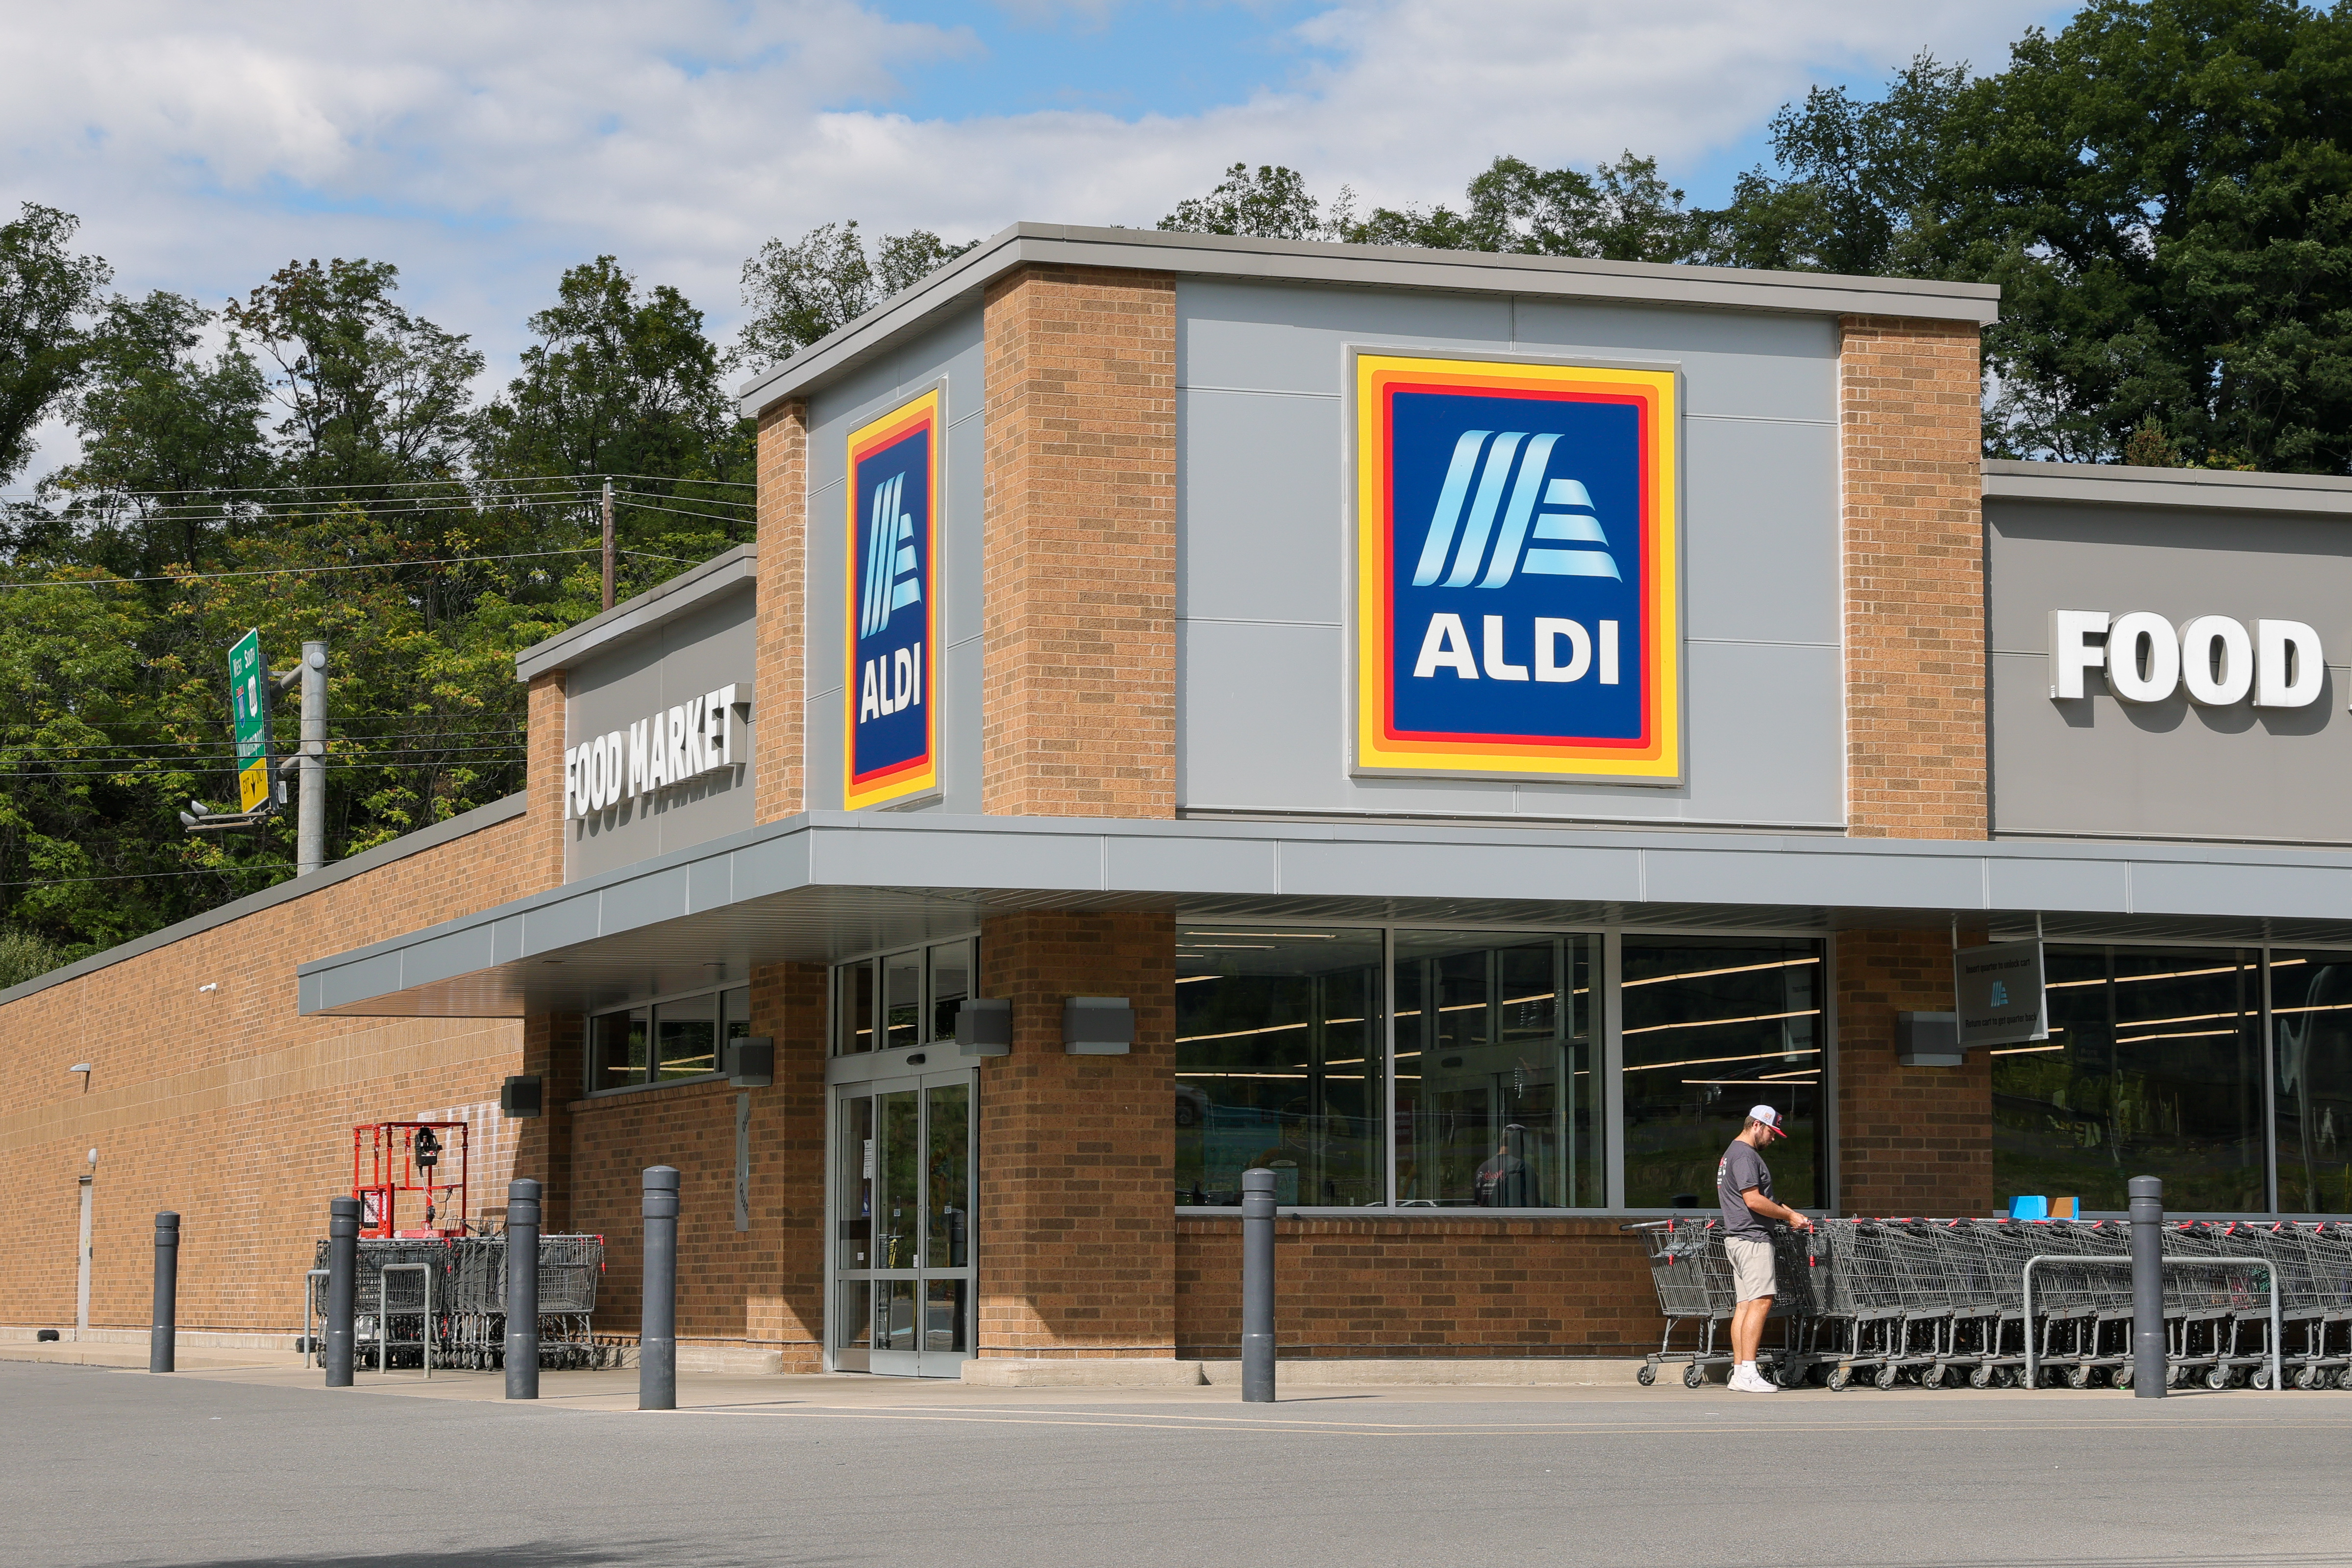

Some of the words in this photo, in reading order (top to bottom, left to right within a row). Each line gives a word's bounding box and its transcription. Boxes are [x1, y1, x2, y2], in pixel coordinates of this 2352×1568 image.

[860, 642, 920, 724] ALDI
[1413, 612, 1619, 685] ALDI
[2053, 609, 2324, 707] FOOD
[565, 730, 625, 821] FOOD
[628, 682, 737, 798] MARKET
[1966, 965, 1980, 973] Insert
[1981, 963, 1997, 973] quarter
[2004, 959, 2019, 968] unlock
[2020, 958, 2030, 967] cart
[1965, 1019, 1981, 1028] Return
[1982, 1018, 1991, 1026] cart
[2007, 1014, 2024, 1025] quarter
[2025, 1012, 2037, 1020] back
